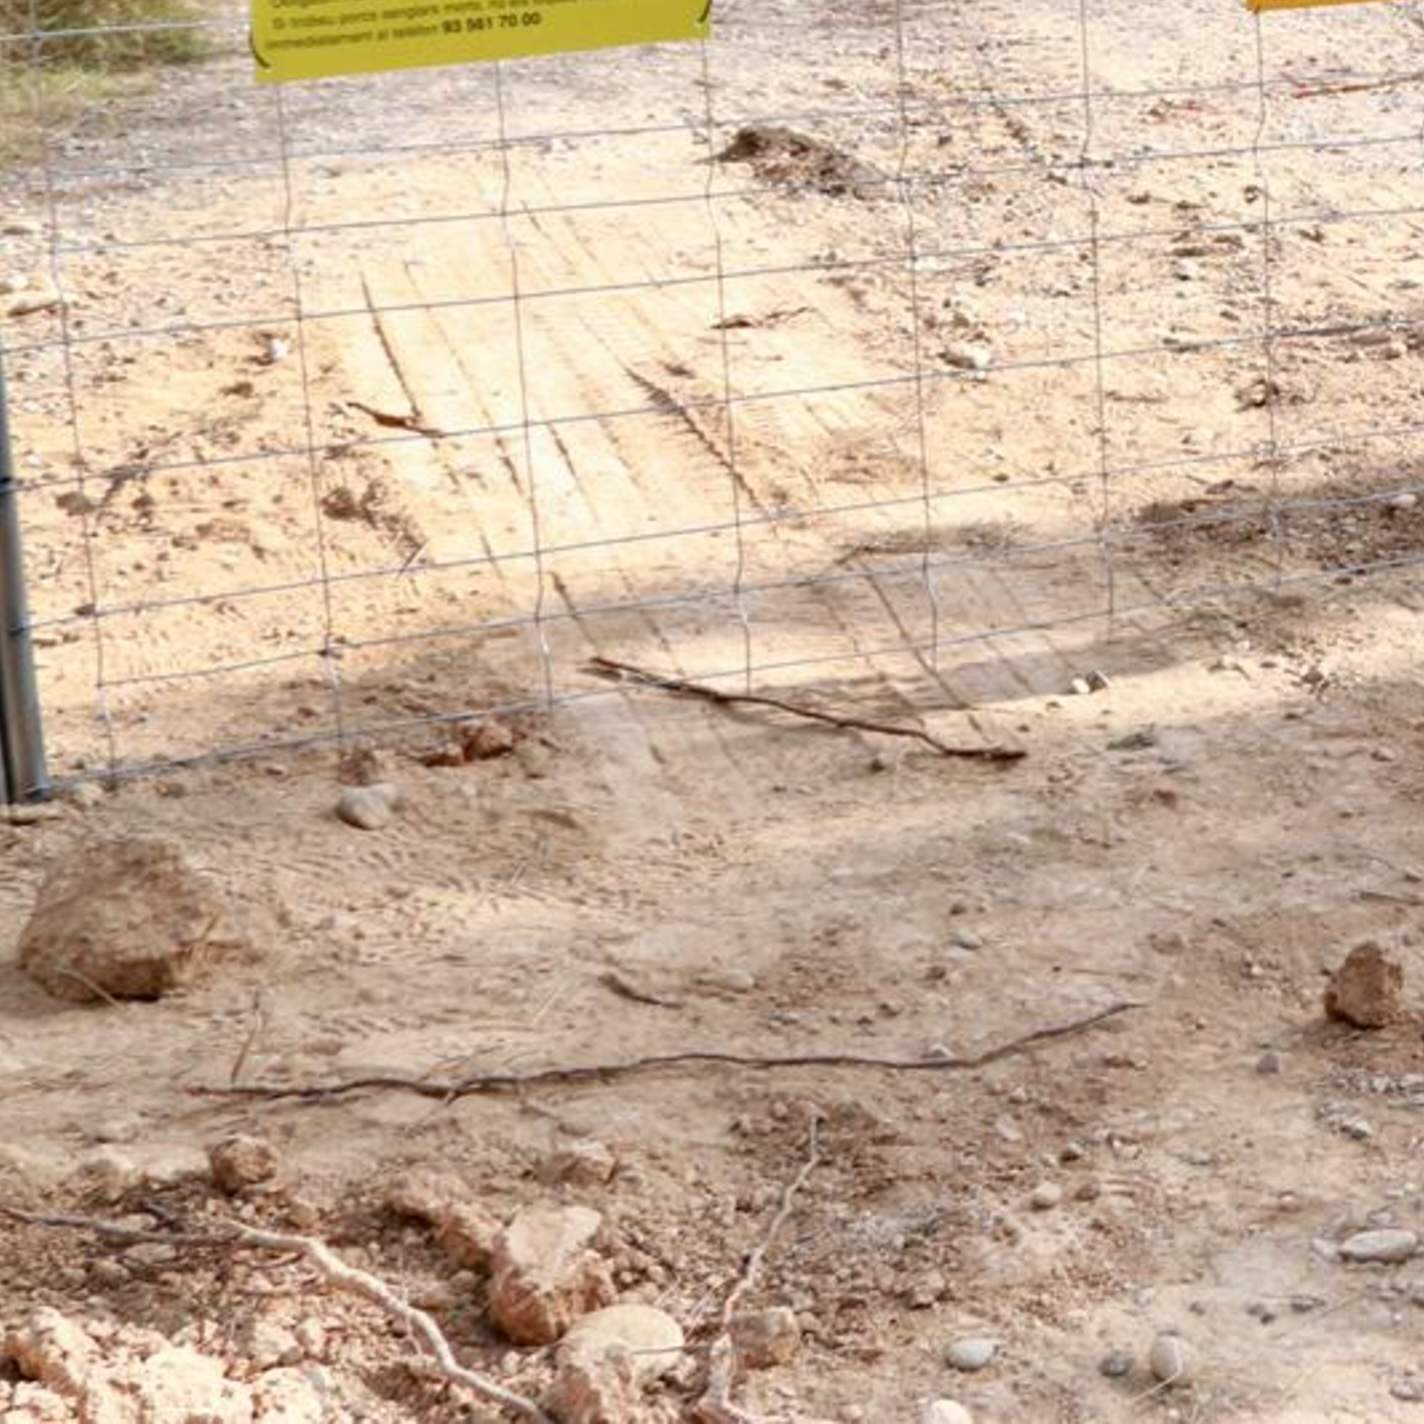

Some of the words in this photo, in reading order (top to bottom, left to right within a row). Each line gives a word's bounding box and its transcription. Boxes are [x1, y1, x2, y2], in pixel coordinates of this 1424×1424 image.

[441, 19, 462, 34] 93
[498, 13, 518, 29] 70
[521, 10, 542, 26] 00
